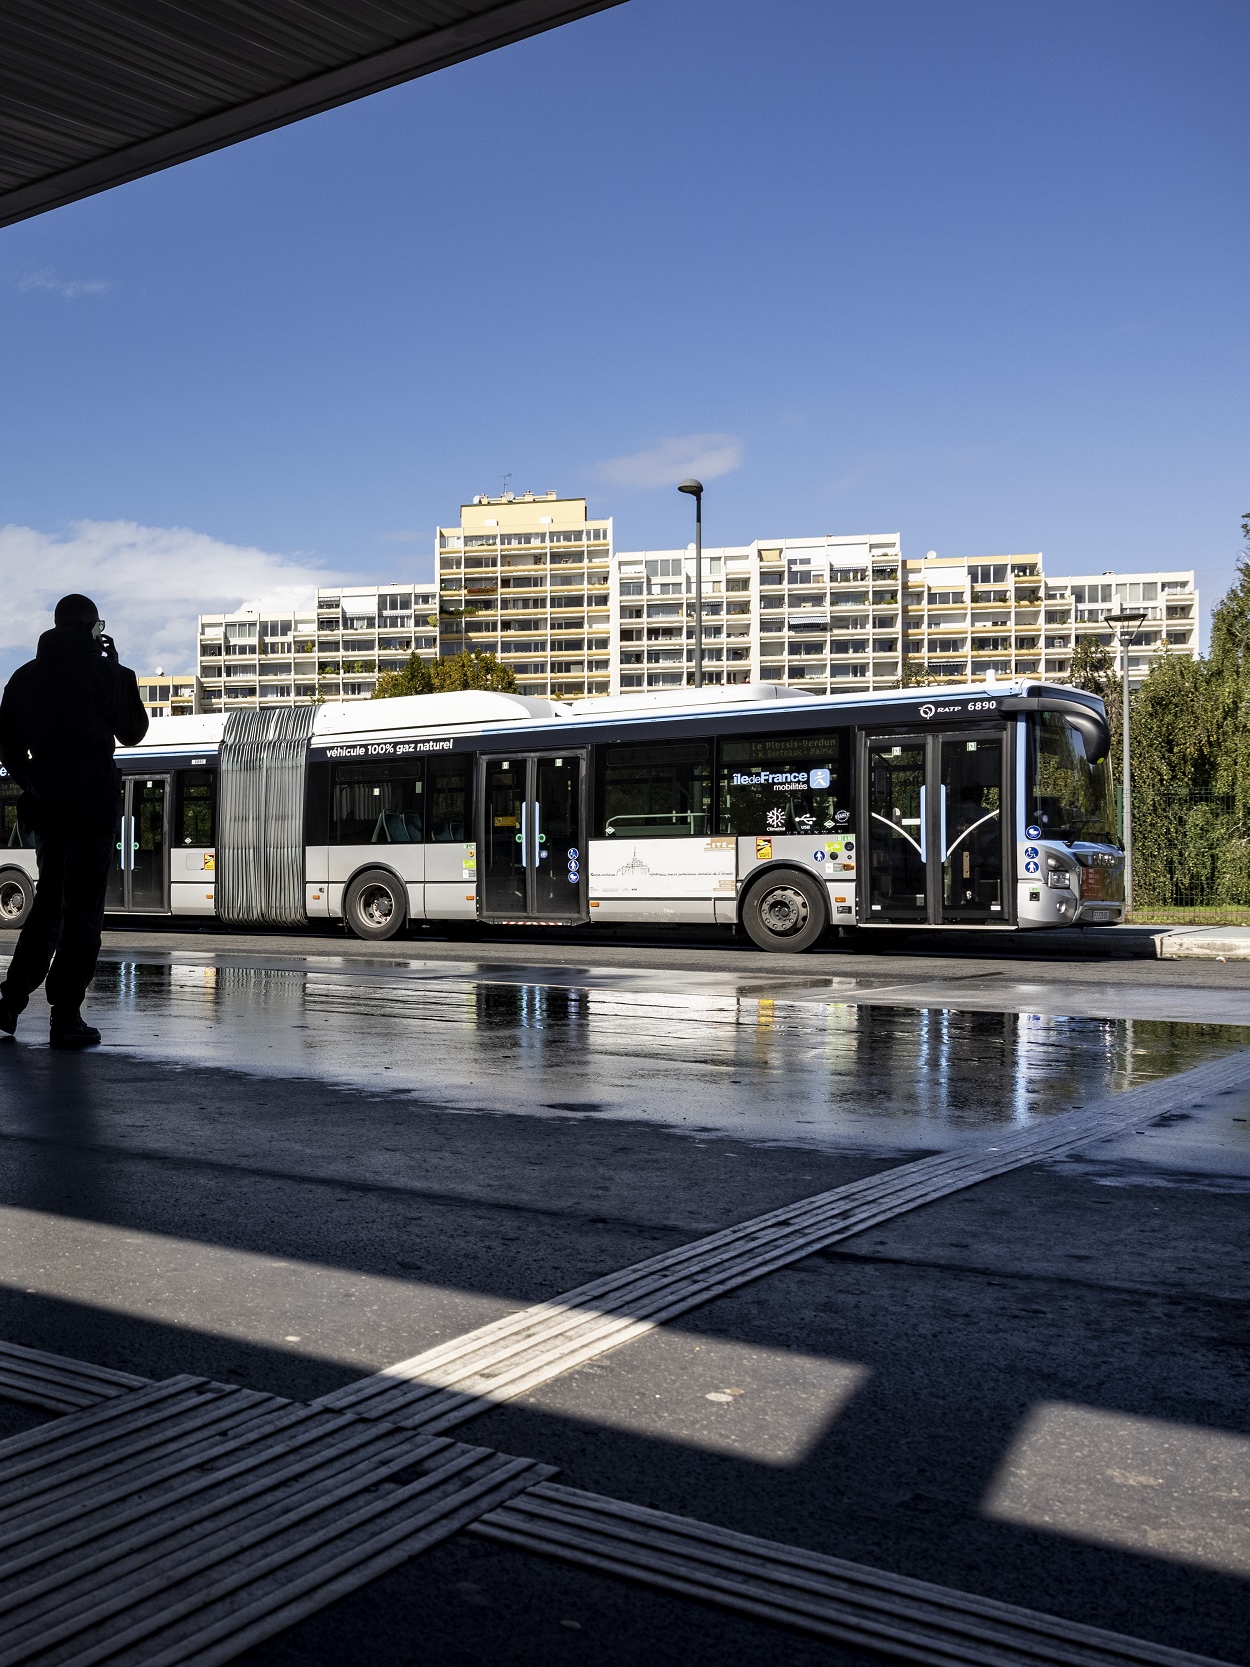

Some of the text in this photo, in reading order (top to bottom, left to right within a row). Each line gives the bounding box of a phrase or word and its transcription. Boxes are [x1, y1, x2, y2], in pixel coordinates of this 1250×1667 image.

[967, 700, 997, 711] 6890
[326, 739, 454, 757] véhicule 100% gaz naturel
[752, 739, 836, 750] Le Plessis-Verdun
[767, 749, 802, 758] Berteaux
[810, 746, 833, 756] Mairie
[773, 782, 808, 791] mobilités
